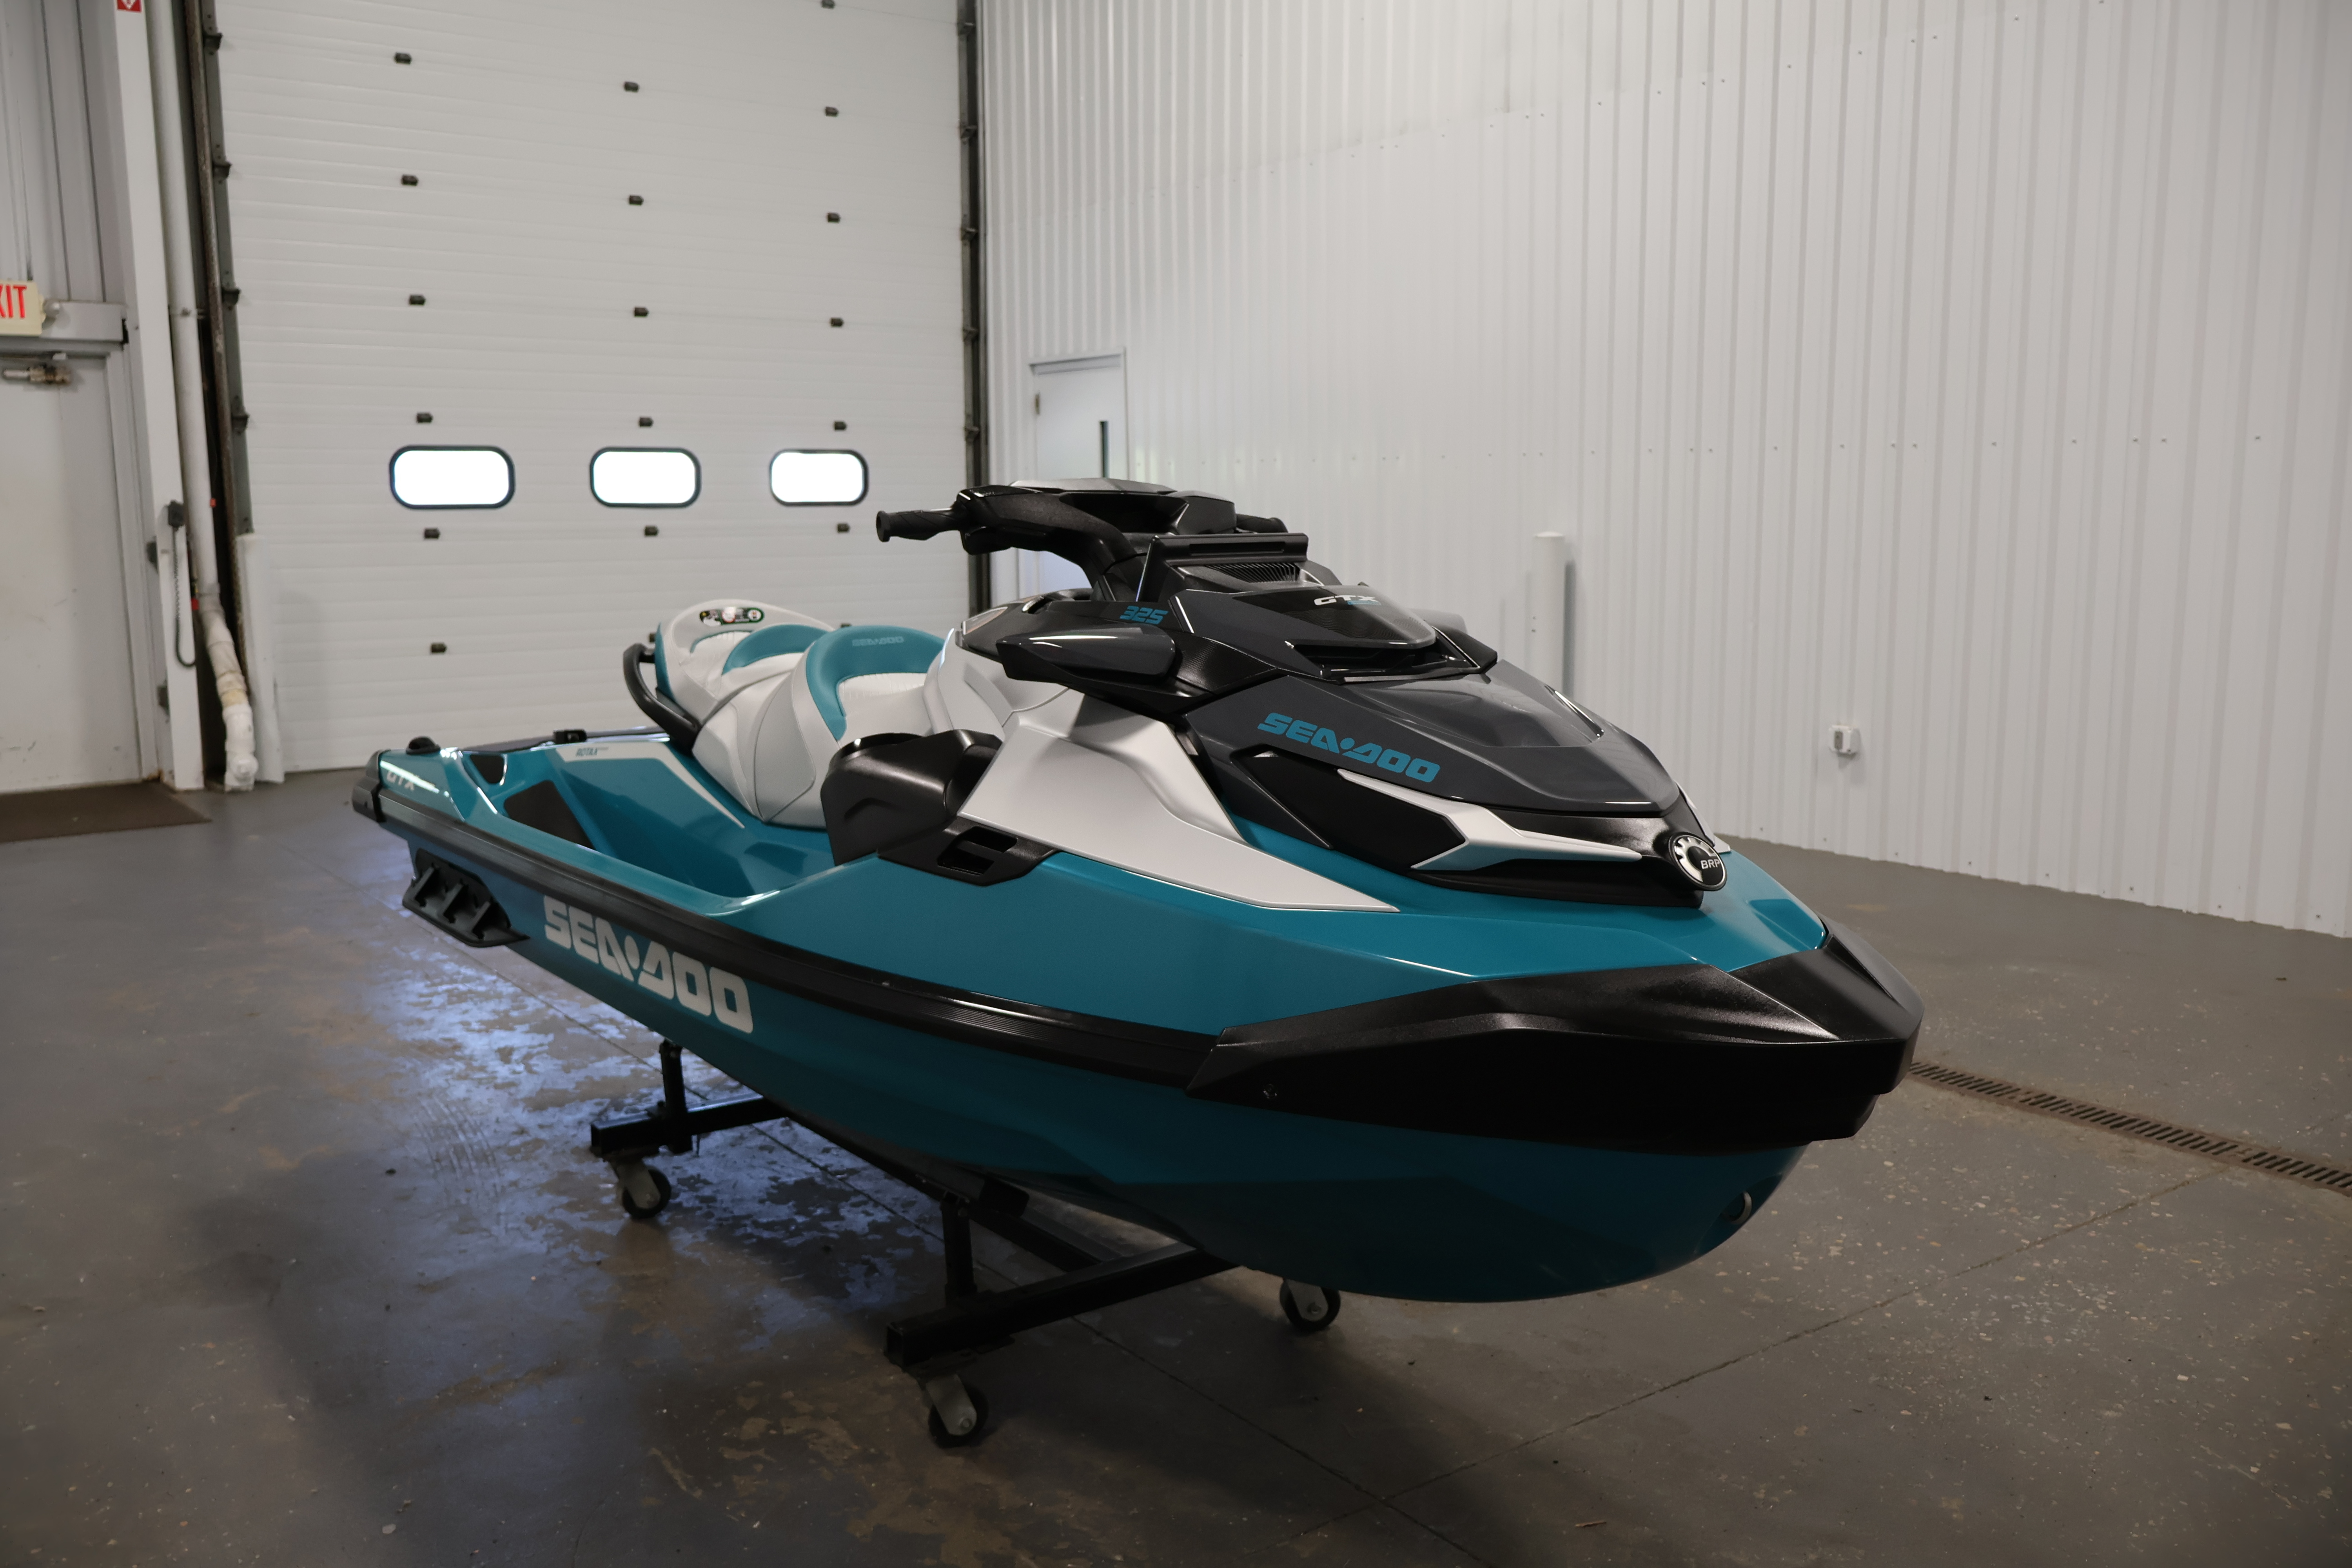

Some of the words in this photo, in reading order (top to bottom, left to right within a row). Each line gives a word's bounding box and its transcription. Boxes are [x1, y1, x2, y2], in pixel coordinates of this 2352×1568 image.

[1314, 595, 1378, 606] GTX
[1120, 606, 1169, 624] 325
[1700, 859, 1720, 869] BRP
